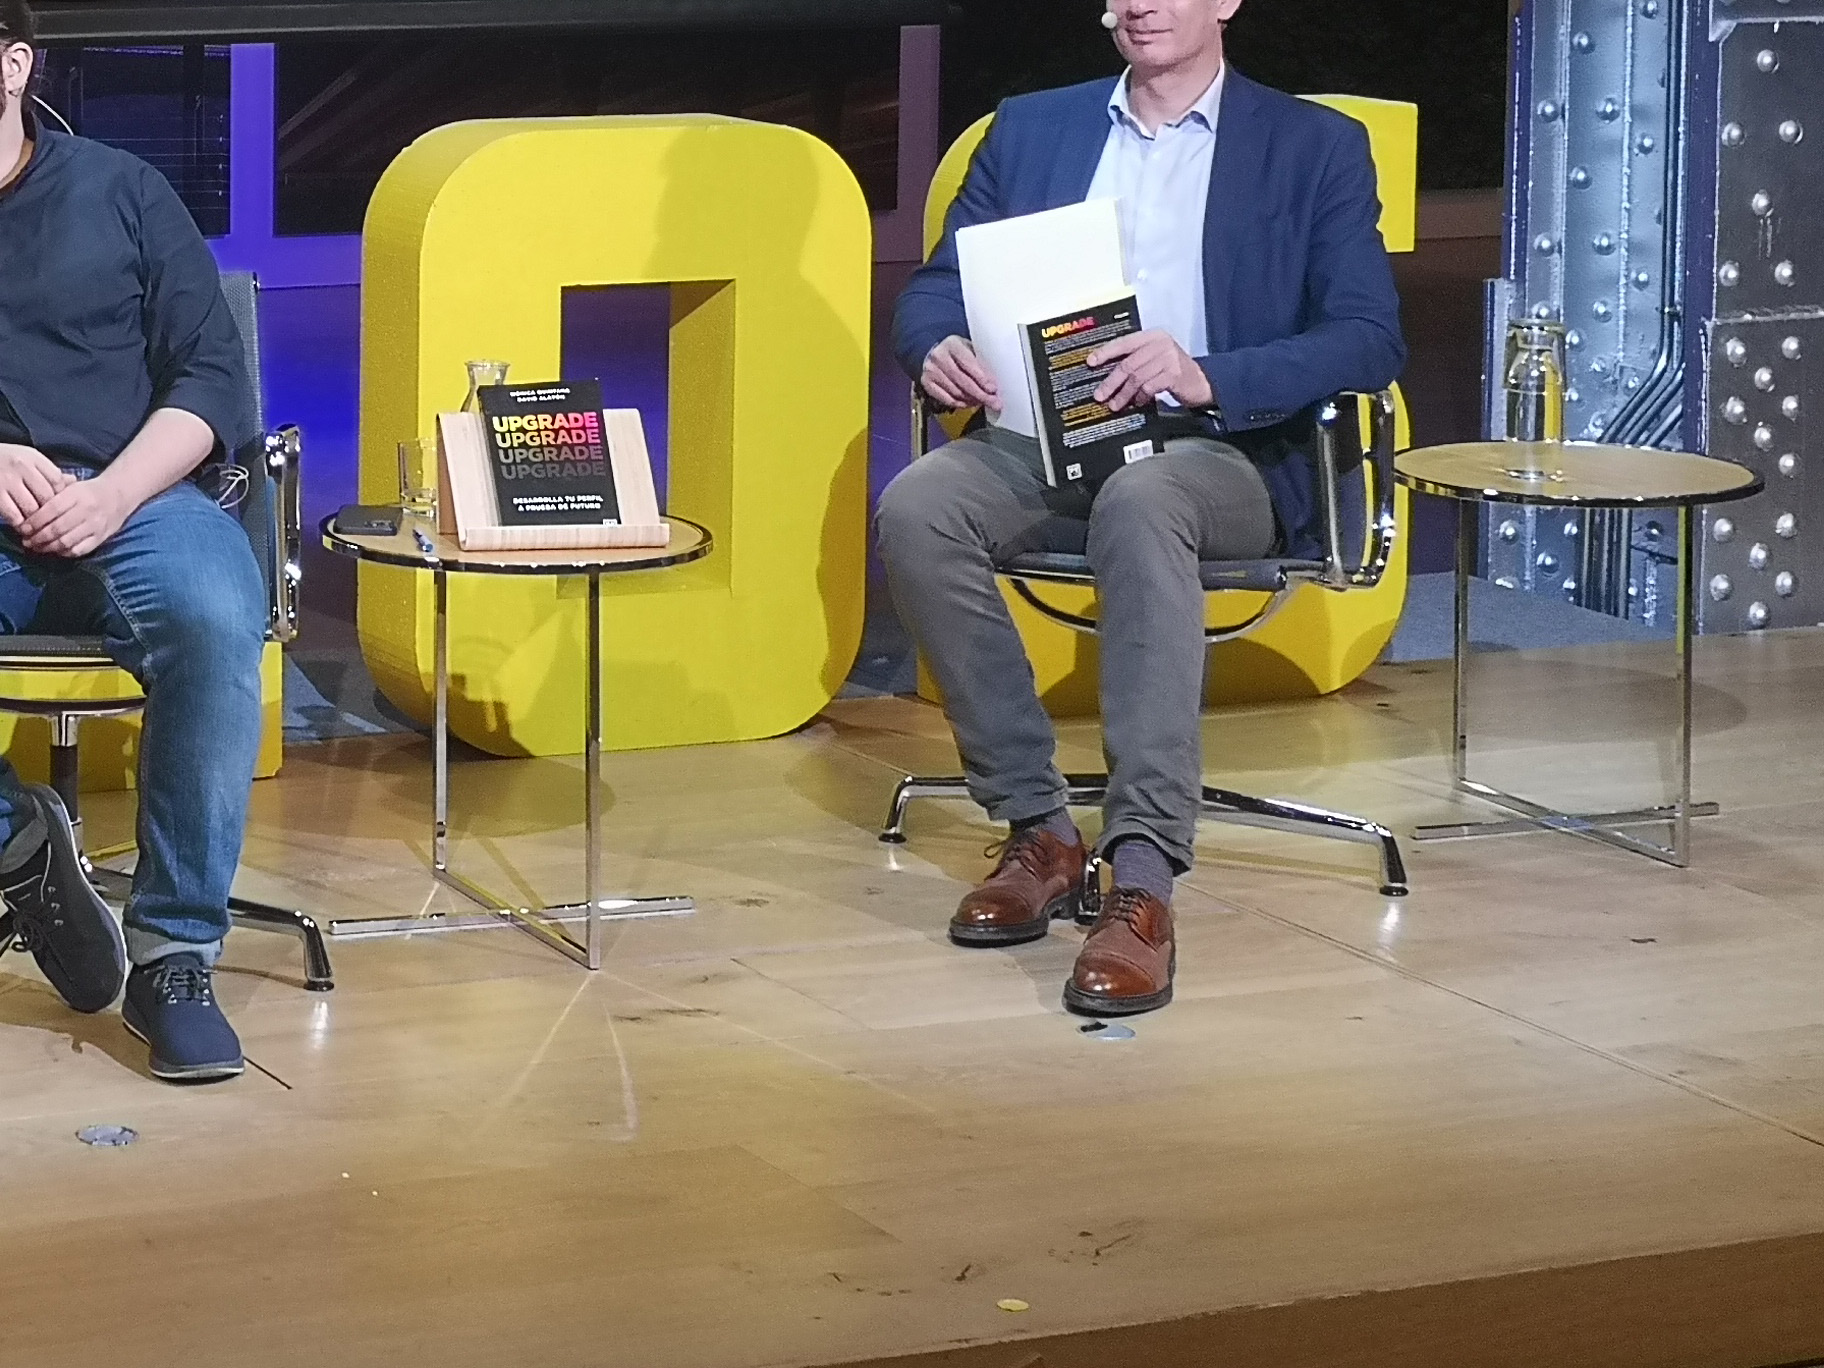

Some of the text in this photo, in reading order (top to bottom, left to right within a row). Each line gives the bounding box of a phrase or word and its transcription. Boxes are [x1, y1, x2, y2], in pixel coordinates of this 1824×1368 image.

[1041, 316, 1096, 338] UPGRADE
[492, 411, 599, 433] UPGRADE
[495, 428, 601, 448] UPGRADE
[498, 444, 604, 464] UPGRADE
[500, 460, 607, 480] UPGRADE
